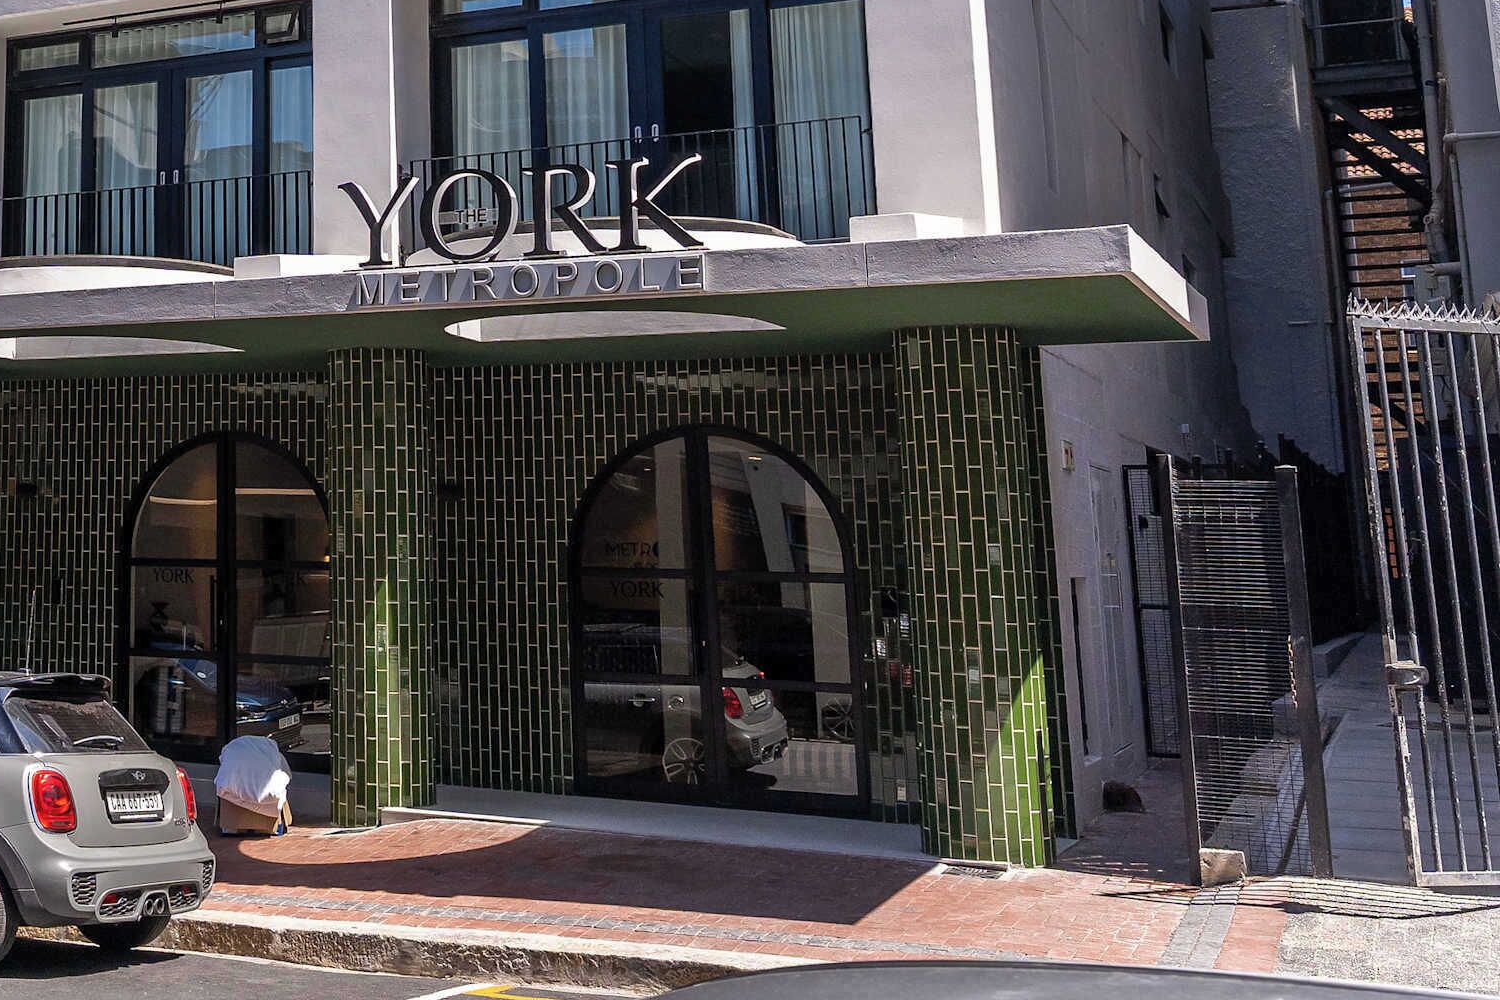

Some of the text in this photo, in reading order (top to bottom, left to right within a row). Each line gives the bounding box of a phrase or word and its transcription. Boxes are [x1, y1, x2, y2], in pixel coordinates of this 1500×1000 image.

[337, 152, 704, 268] YORK
[454, 208, 488, 225] THE
[357, 254, 704, 306] METROPOLE
[153, 568, 194, 585] YORK
[610, 580, 664, 598] YORK
[110, 793, 127, 810] CAA
